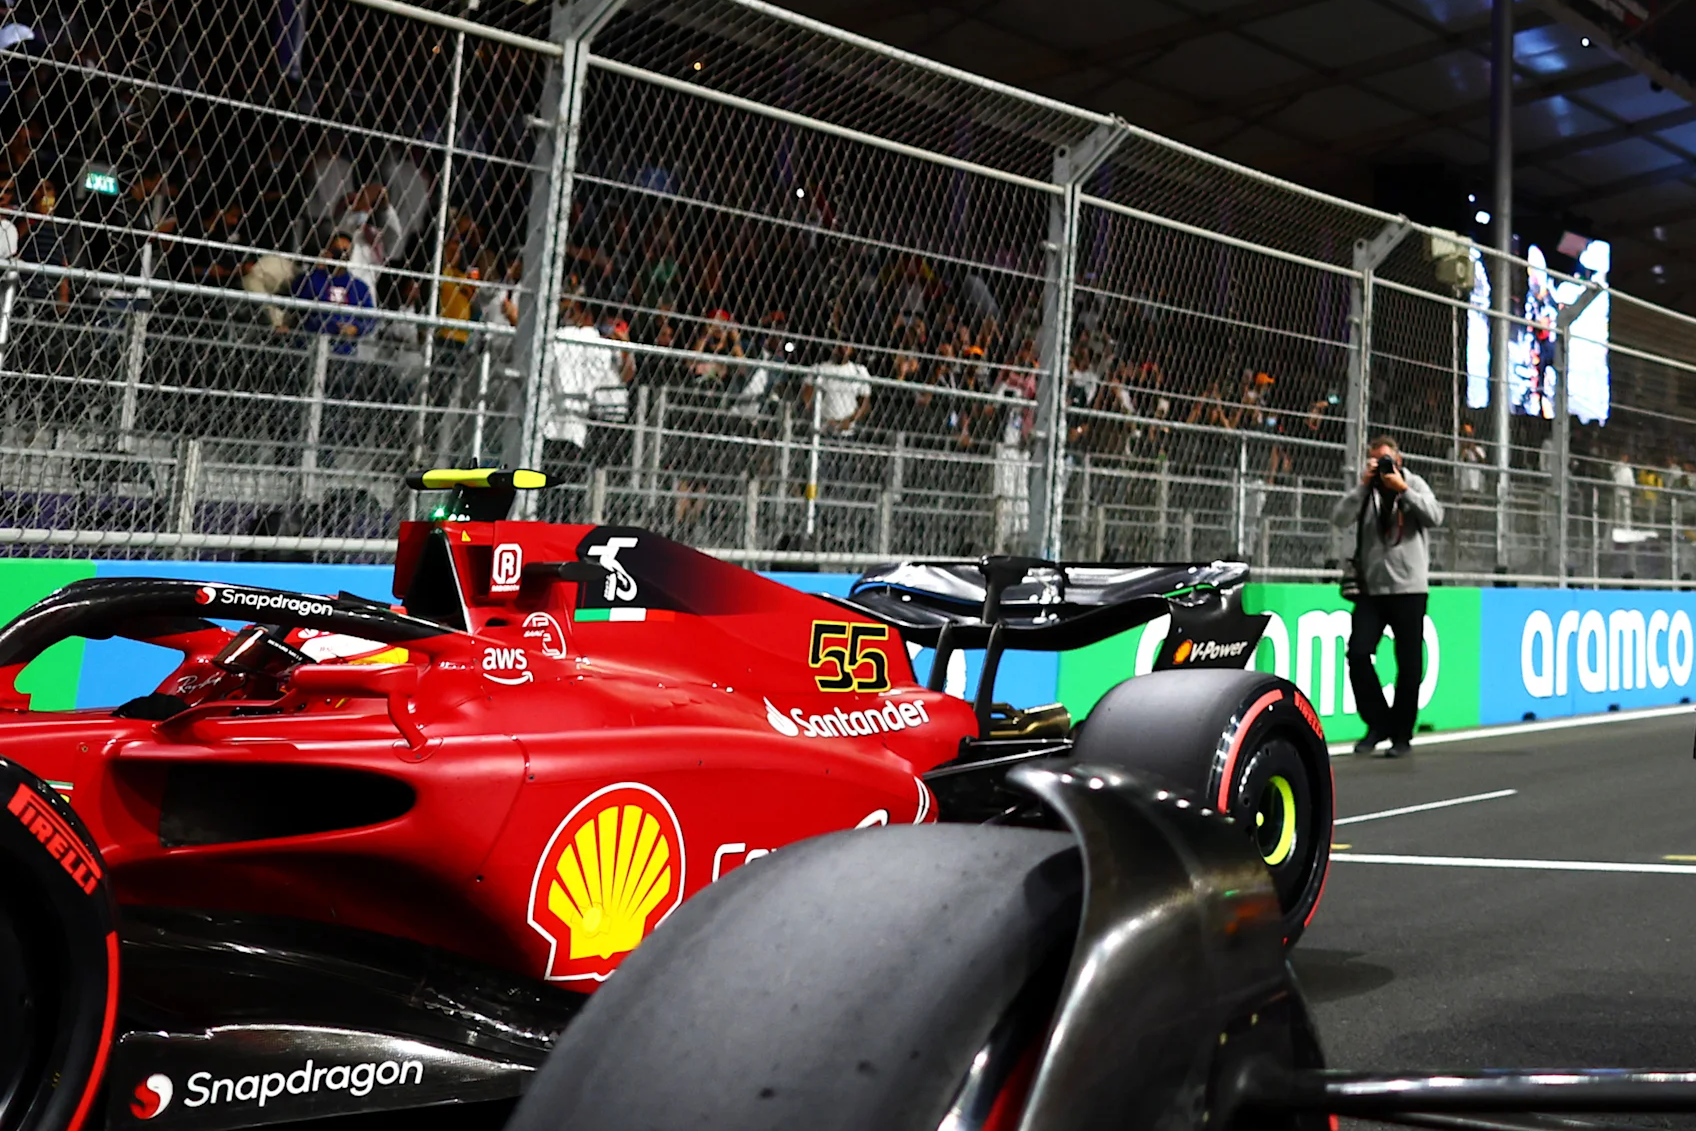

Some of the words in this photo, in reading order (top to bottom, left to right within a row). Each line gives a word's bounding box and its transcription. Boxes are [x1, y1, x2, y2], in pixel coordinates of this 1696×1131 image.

[220, 588, 334, 617] Snapdragon
[482, 647, 528, 670] aws
[809, 620, 892, 693] 55
[1190, 639, 1249, 663] V-Power
[1521, 608, 1694, 698] aramco
[790, 699, 930, 738] Santander
[7, 782, 103, 896] PIRELLI
[183, 1058, 424, 1108] Snapdragon
